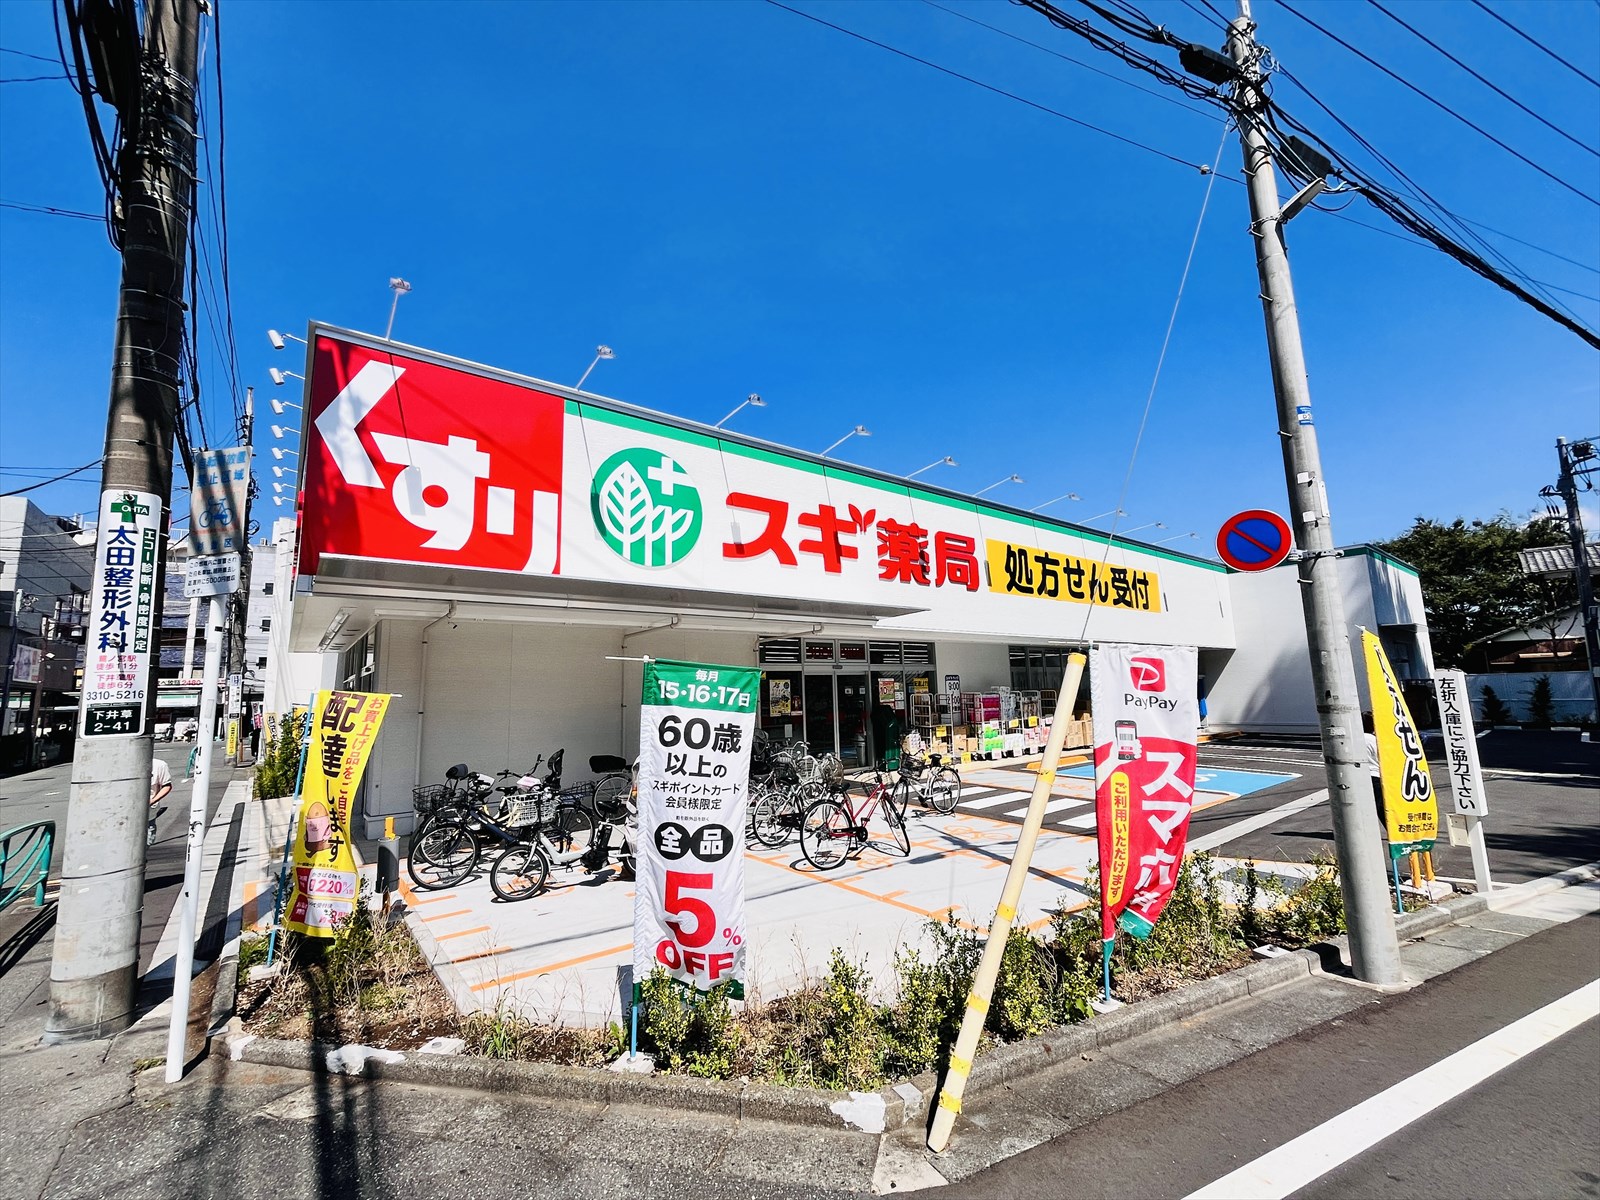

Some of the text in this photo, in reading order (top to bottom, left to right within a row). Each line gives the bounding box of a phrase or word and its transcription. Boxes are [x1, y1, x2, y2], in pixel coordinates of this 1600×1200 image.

[314, 359, 559, 575] くすり
[121, 504, 149, 515] OHTA
[722, 491, 980, 592] スギ薬局
[97, 525, 138, 653] 太田整形外科
[134, 530, 155, 650] エコー診断・骨密度測定
[1005, 543, 1150, 610] 処方せん受付
[97, 681, 134, 690] 徒歩6分
[695, 669, 719, 683] 毎月
[86, 690, 145, 701] 3310-5216
[1124, 693, 1178, 712] PayPay
[93, 709, 134, 720] 下井草
[93, 721, 130, 732] 2-41
[658, 715, 743, 754] 60歳
[1438, 677, 1476, 810] 左折入庫にご協力下さい
[320, 690, 368, 863] 配達します
[664, 753, 727, 779] 以上の
[652, 780, 742, 796] スギポイントカード
[665, 796, 723, 810] 会員様限定
[660, 826, 723, 856] 全品
[1109, 782, 1128, 899] ご利用いただけます
[664, 870, 742, 948] 5%
[656, 939, 734, 981] OFF
